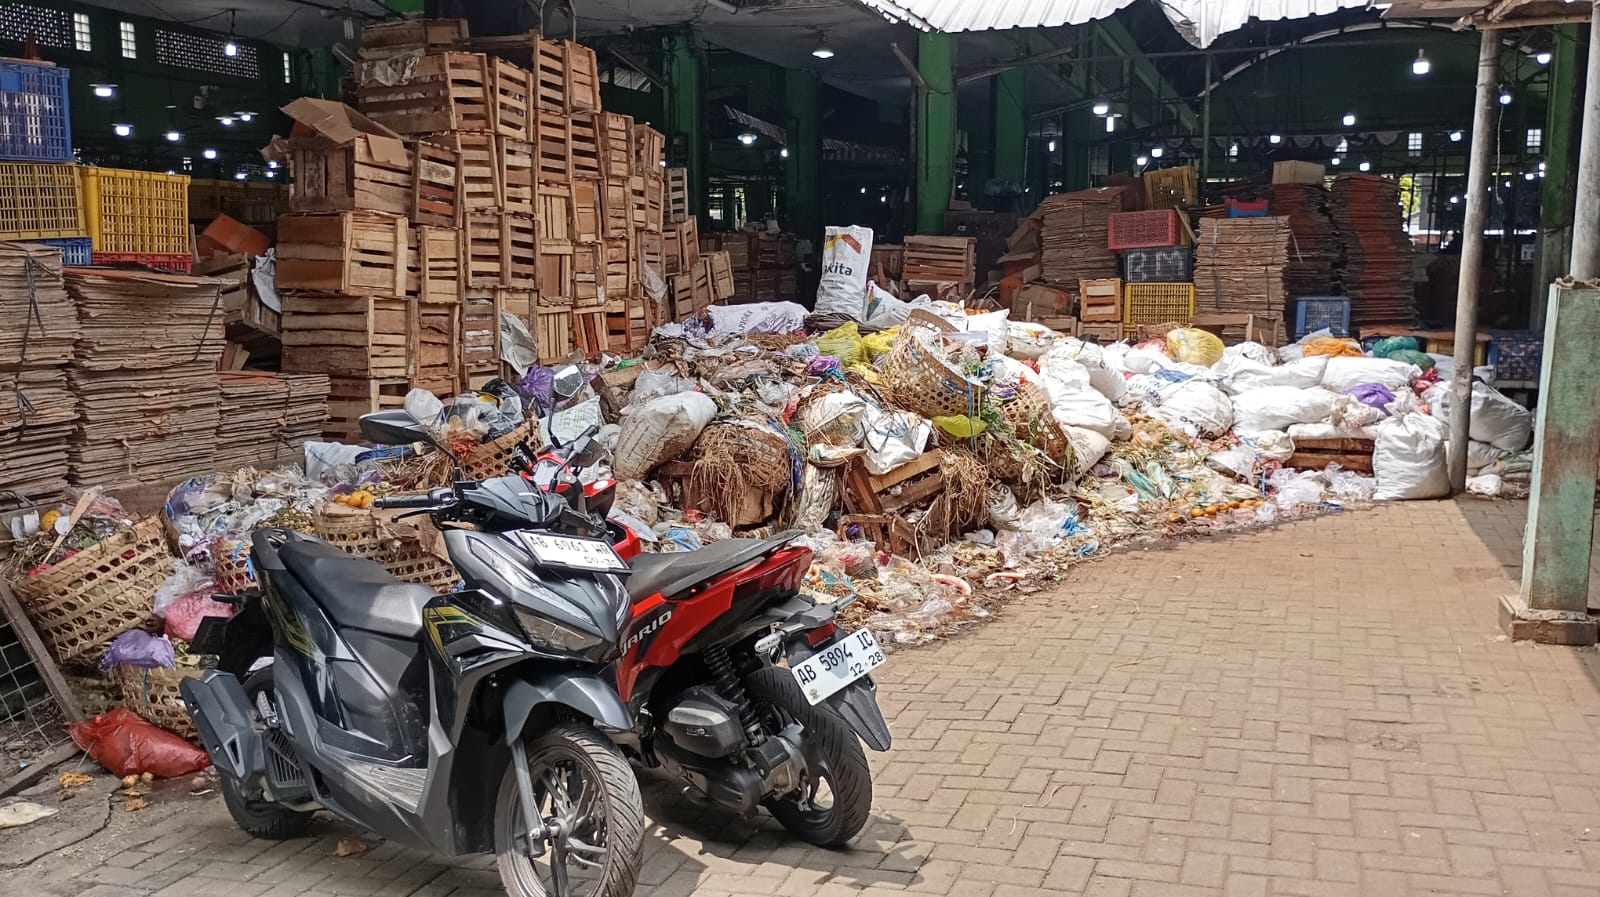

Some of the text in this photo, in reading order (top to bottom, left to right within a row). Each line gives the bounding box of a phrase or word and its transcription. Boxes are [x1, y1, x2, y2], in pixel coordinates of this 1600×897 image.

[530, 535, 550, 549] AB
[554, 538, 589, 553] 6961
[797, 664, 817, 685] AB
[818, 642, 853, 671] 5894
